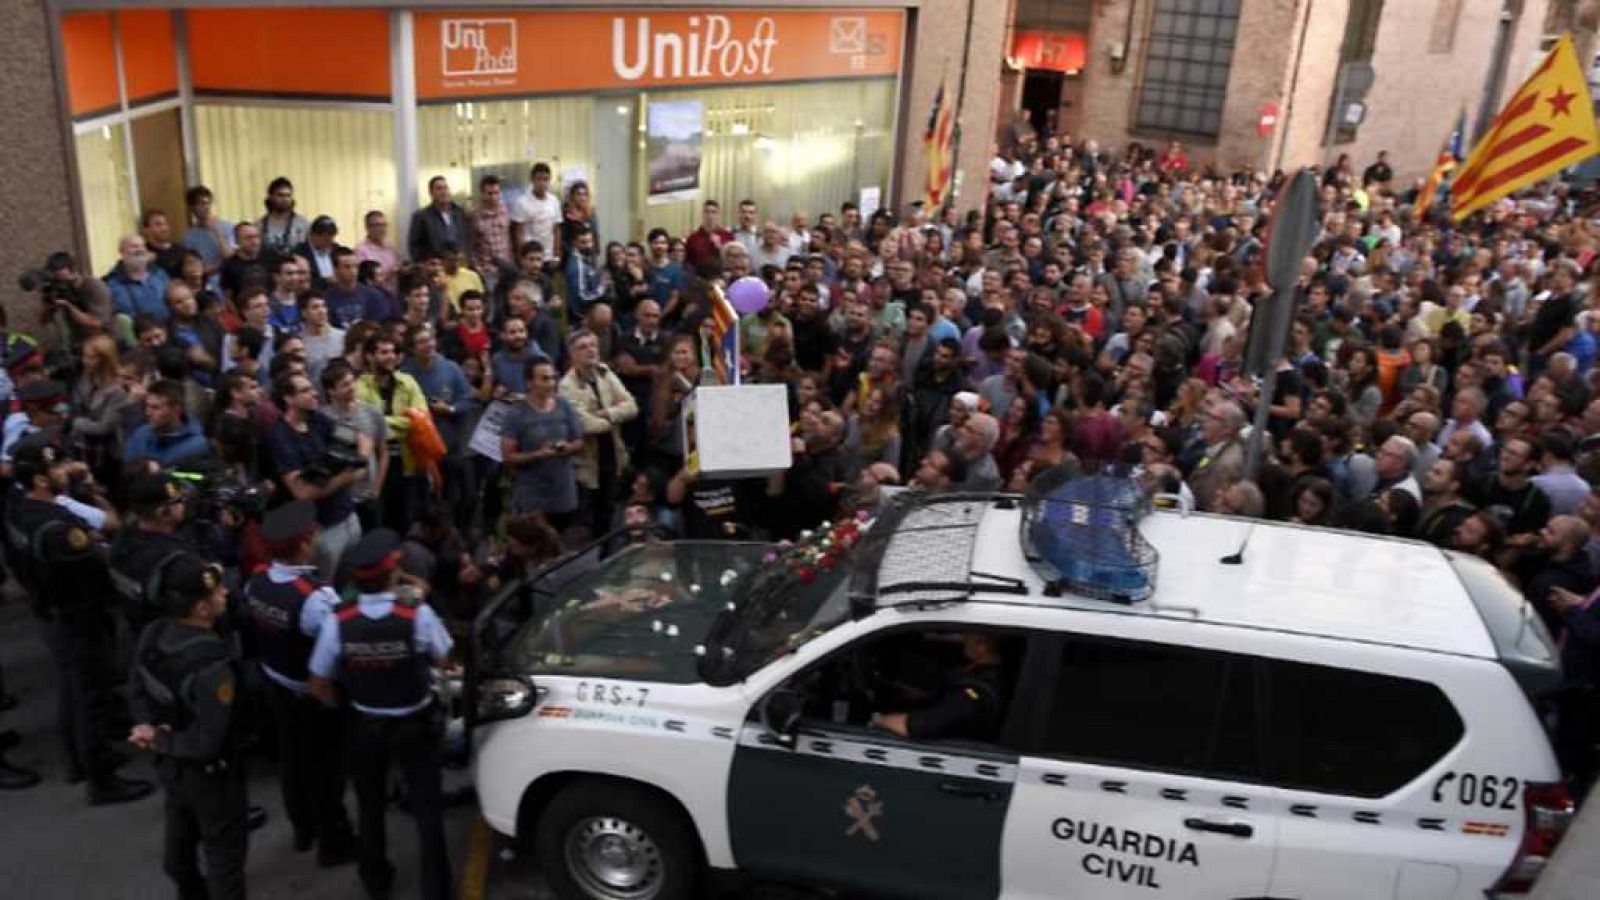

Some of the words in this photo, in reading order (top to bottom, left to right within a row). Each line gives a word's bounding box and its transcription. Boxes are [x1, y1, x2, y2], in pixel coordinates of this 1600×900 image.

[612, 14, 778, 80] UniPost
[1459, 773, 1519, 810] 062
[1052, 816, 1200, 868] GUARDIA
[1082, 853, 1161, 889] CIVIL
